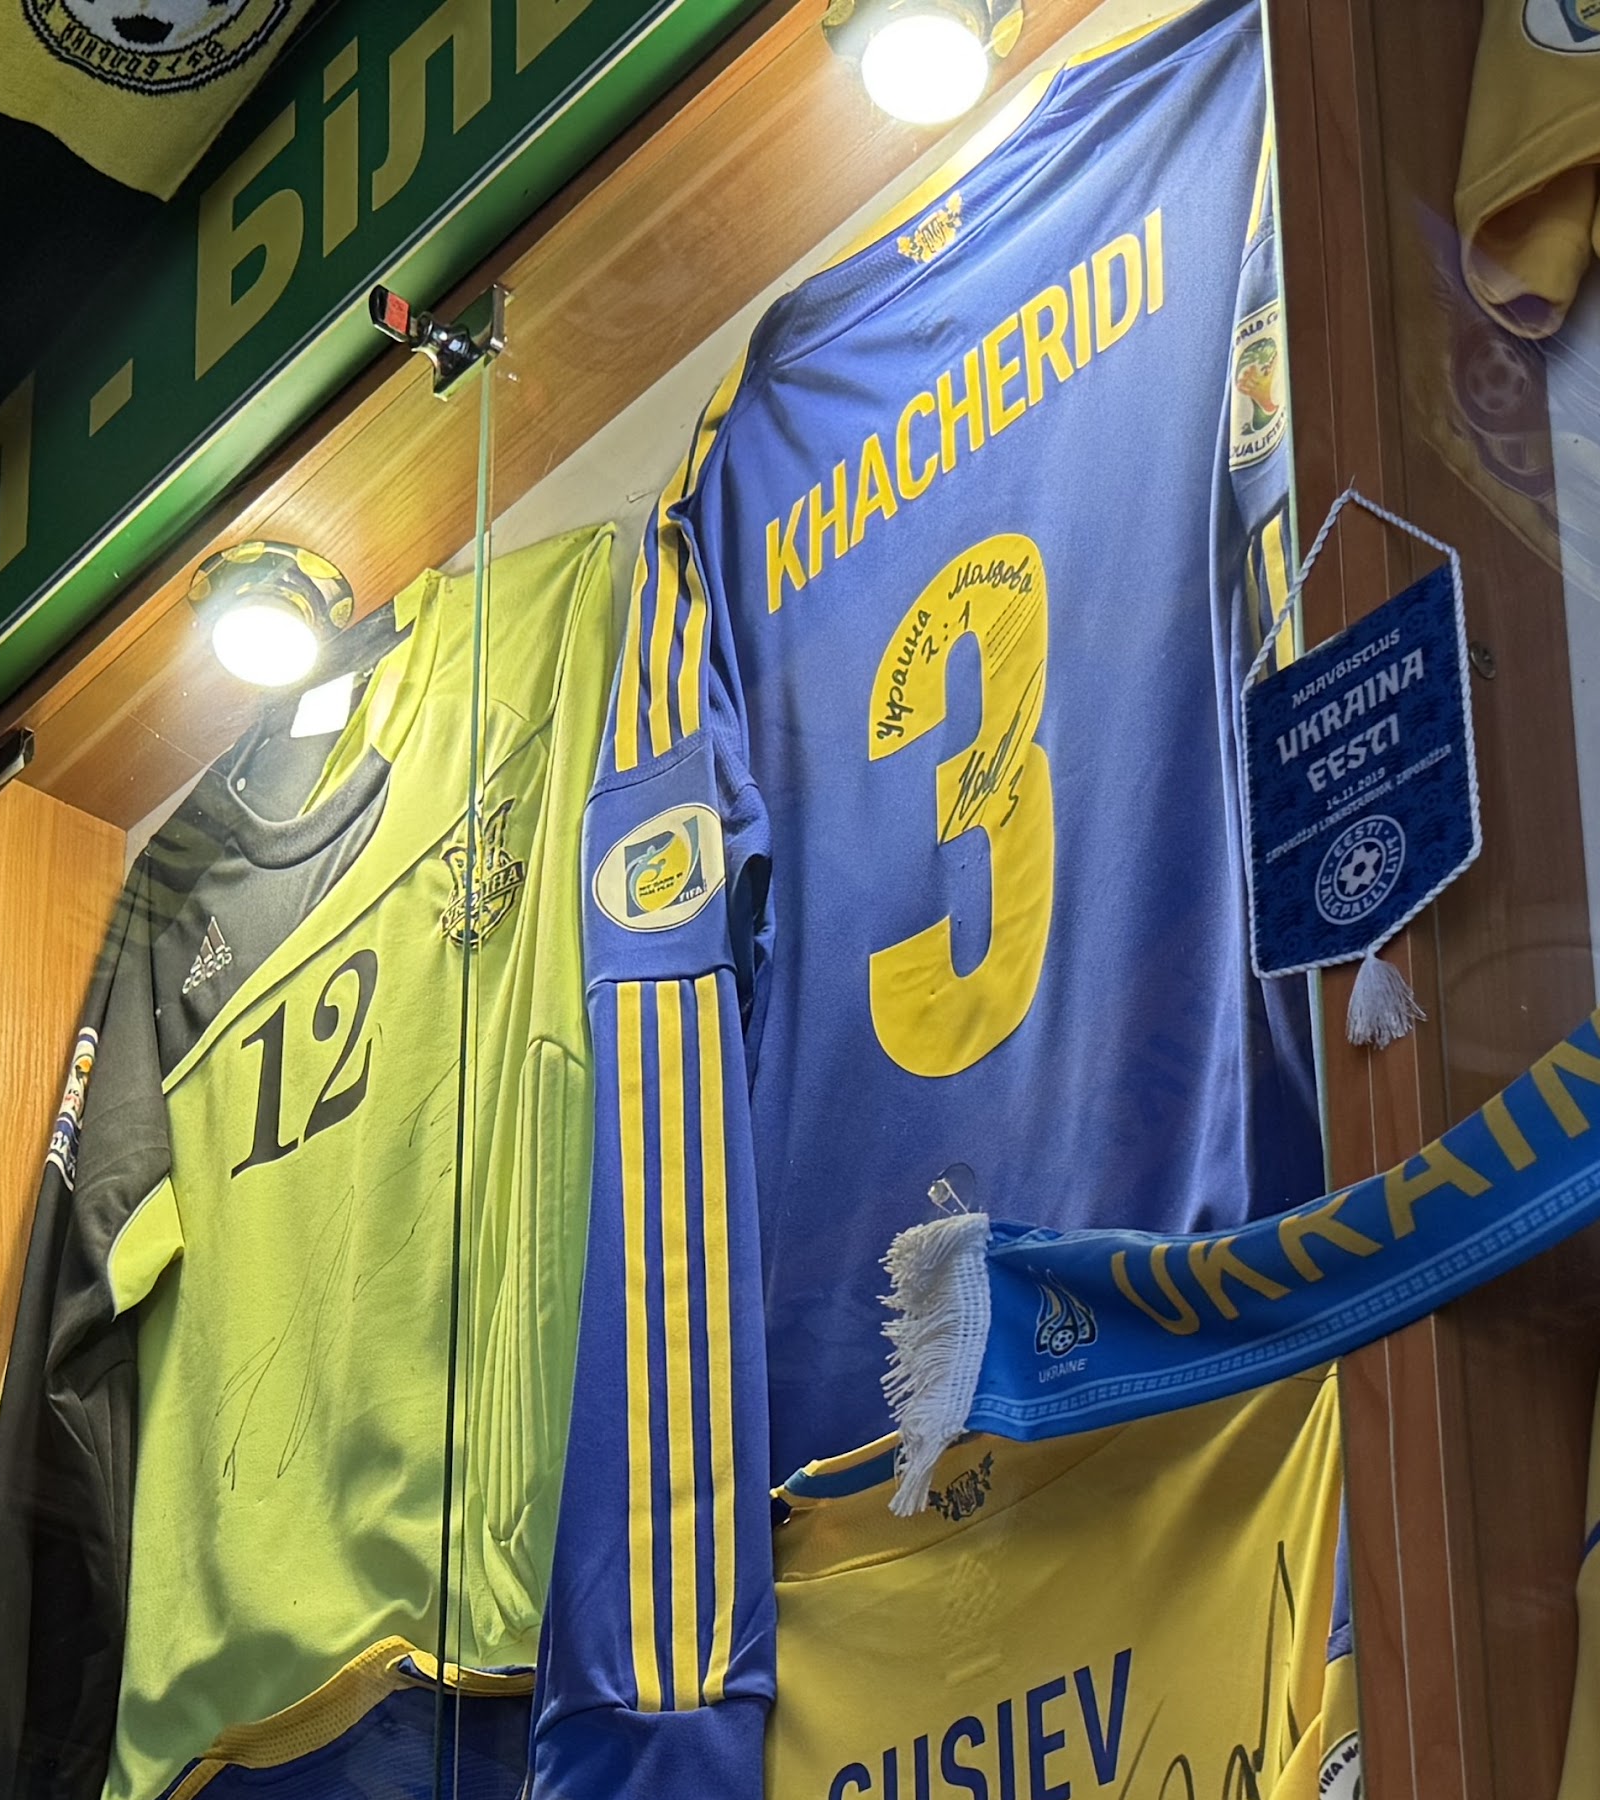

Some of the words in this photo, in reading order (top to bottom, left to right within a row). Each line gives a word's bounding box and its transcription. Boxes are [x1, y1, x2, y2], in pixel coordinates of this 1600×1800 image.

[764, 207, 1164, 615] KHACHERIDI
[1275, 647, 1426, 766] UKRAINA
[1305, 712, 1401, 794] EESTI
[867, 533, 1058, 1078] 3
[1333, 820, 1383, 857] EESTI
[679, 885, 704, 902] FIFA
[230, 948, 380, 1179] 12
[1038, 1356, 1090, 1384] UKRAINE
